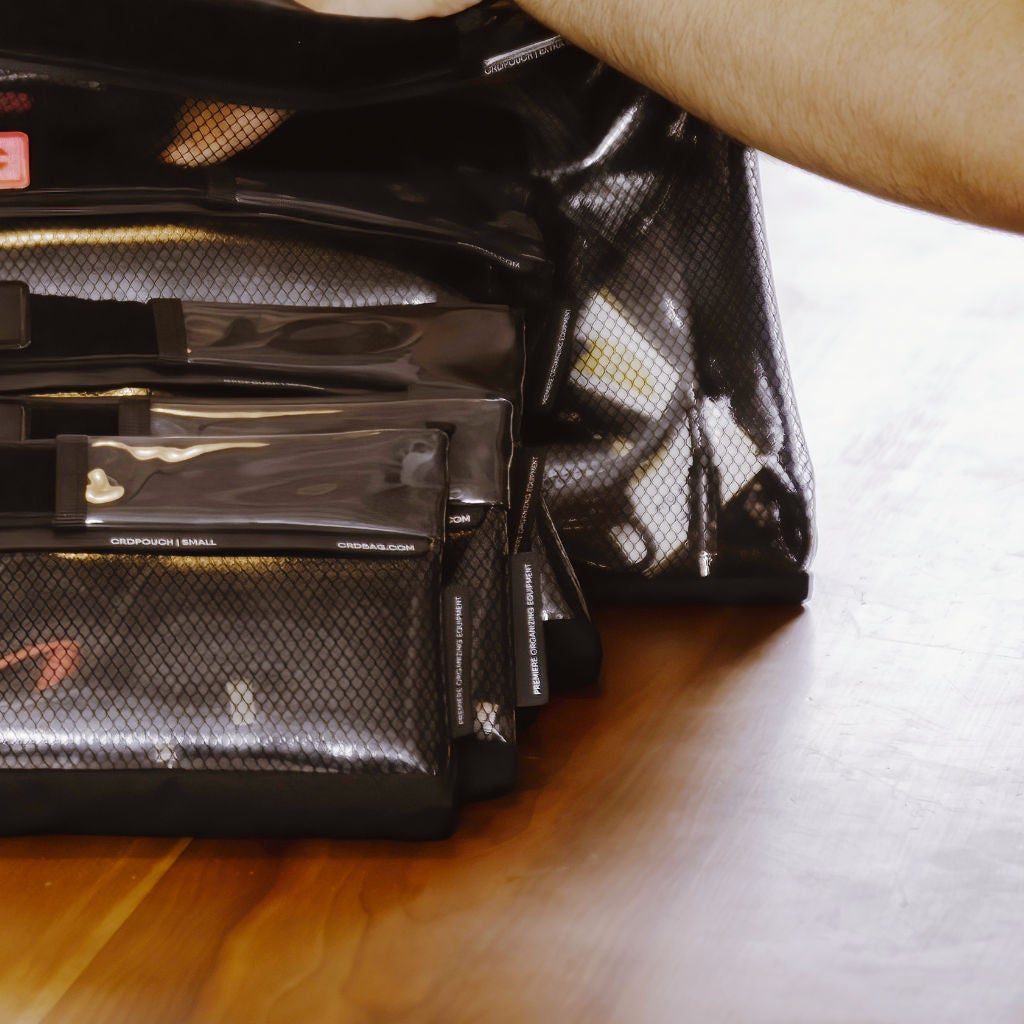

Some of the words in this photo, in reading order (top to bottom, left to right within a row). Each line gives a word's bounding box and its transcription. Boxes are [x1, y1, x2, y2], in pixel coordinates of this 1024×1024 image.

[110, 538, 174, 546] CRDPOUCH
[337, 542, 415, 551] CRDBAG.COM
[525, 563, 535, 606] EQUIPMENT
[455, 596, 463, 637] EQUIPMENT
[527, 607, 538, 656] ORGANIZING
[530, 657, 542, 695] PREMIERE
